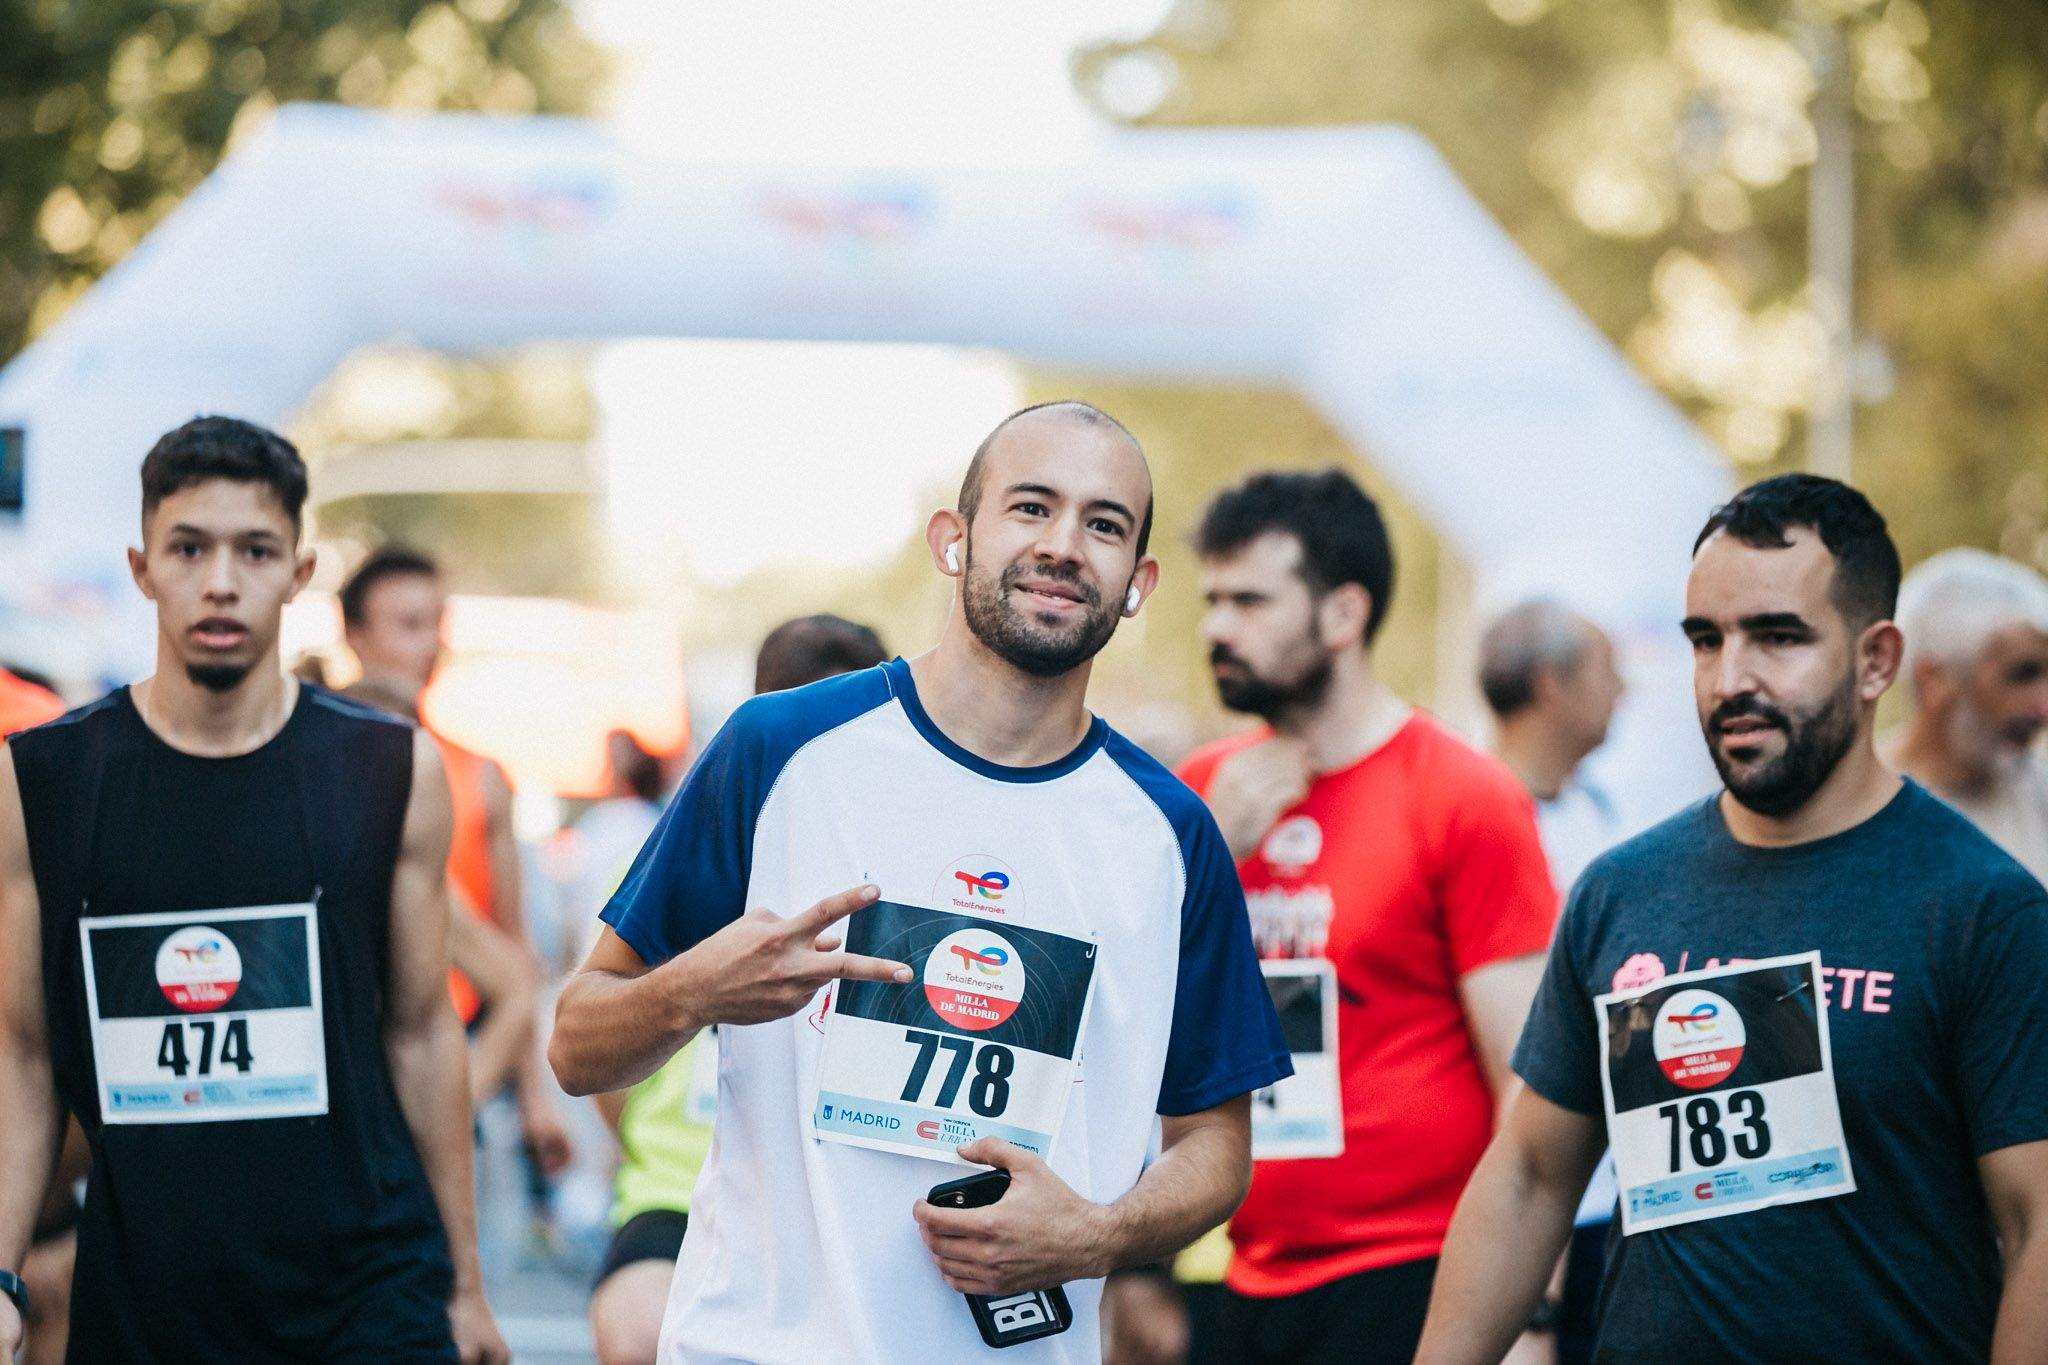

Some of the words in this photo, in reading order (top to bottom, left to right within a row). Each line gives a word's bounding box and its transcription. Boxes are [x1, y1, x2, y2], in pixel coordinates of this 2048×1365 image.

[952, 898, 1006, 915] TotalEnergies
[945, 973, 1005, 991] TotalEnergies
[955, 993, 989, 1008] MILLA
[940, 1002, 956, 1013] DE
[957, 1005, 1000, 1021] MADRID
[158, 1019, 254, 1077] 474
[900, 1030, 1014, 1118] 778
[840, 1109, 901, 1130] MADRID
[943, 1123, 976, 1138] MILLA
[1660, 1090, 1771, 1174] 783
